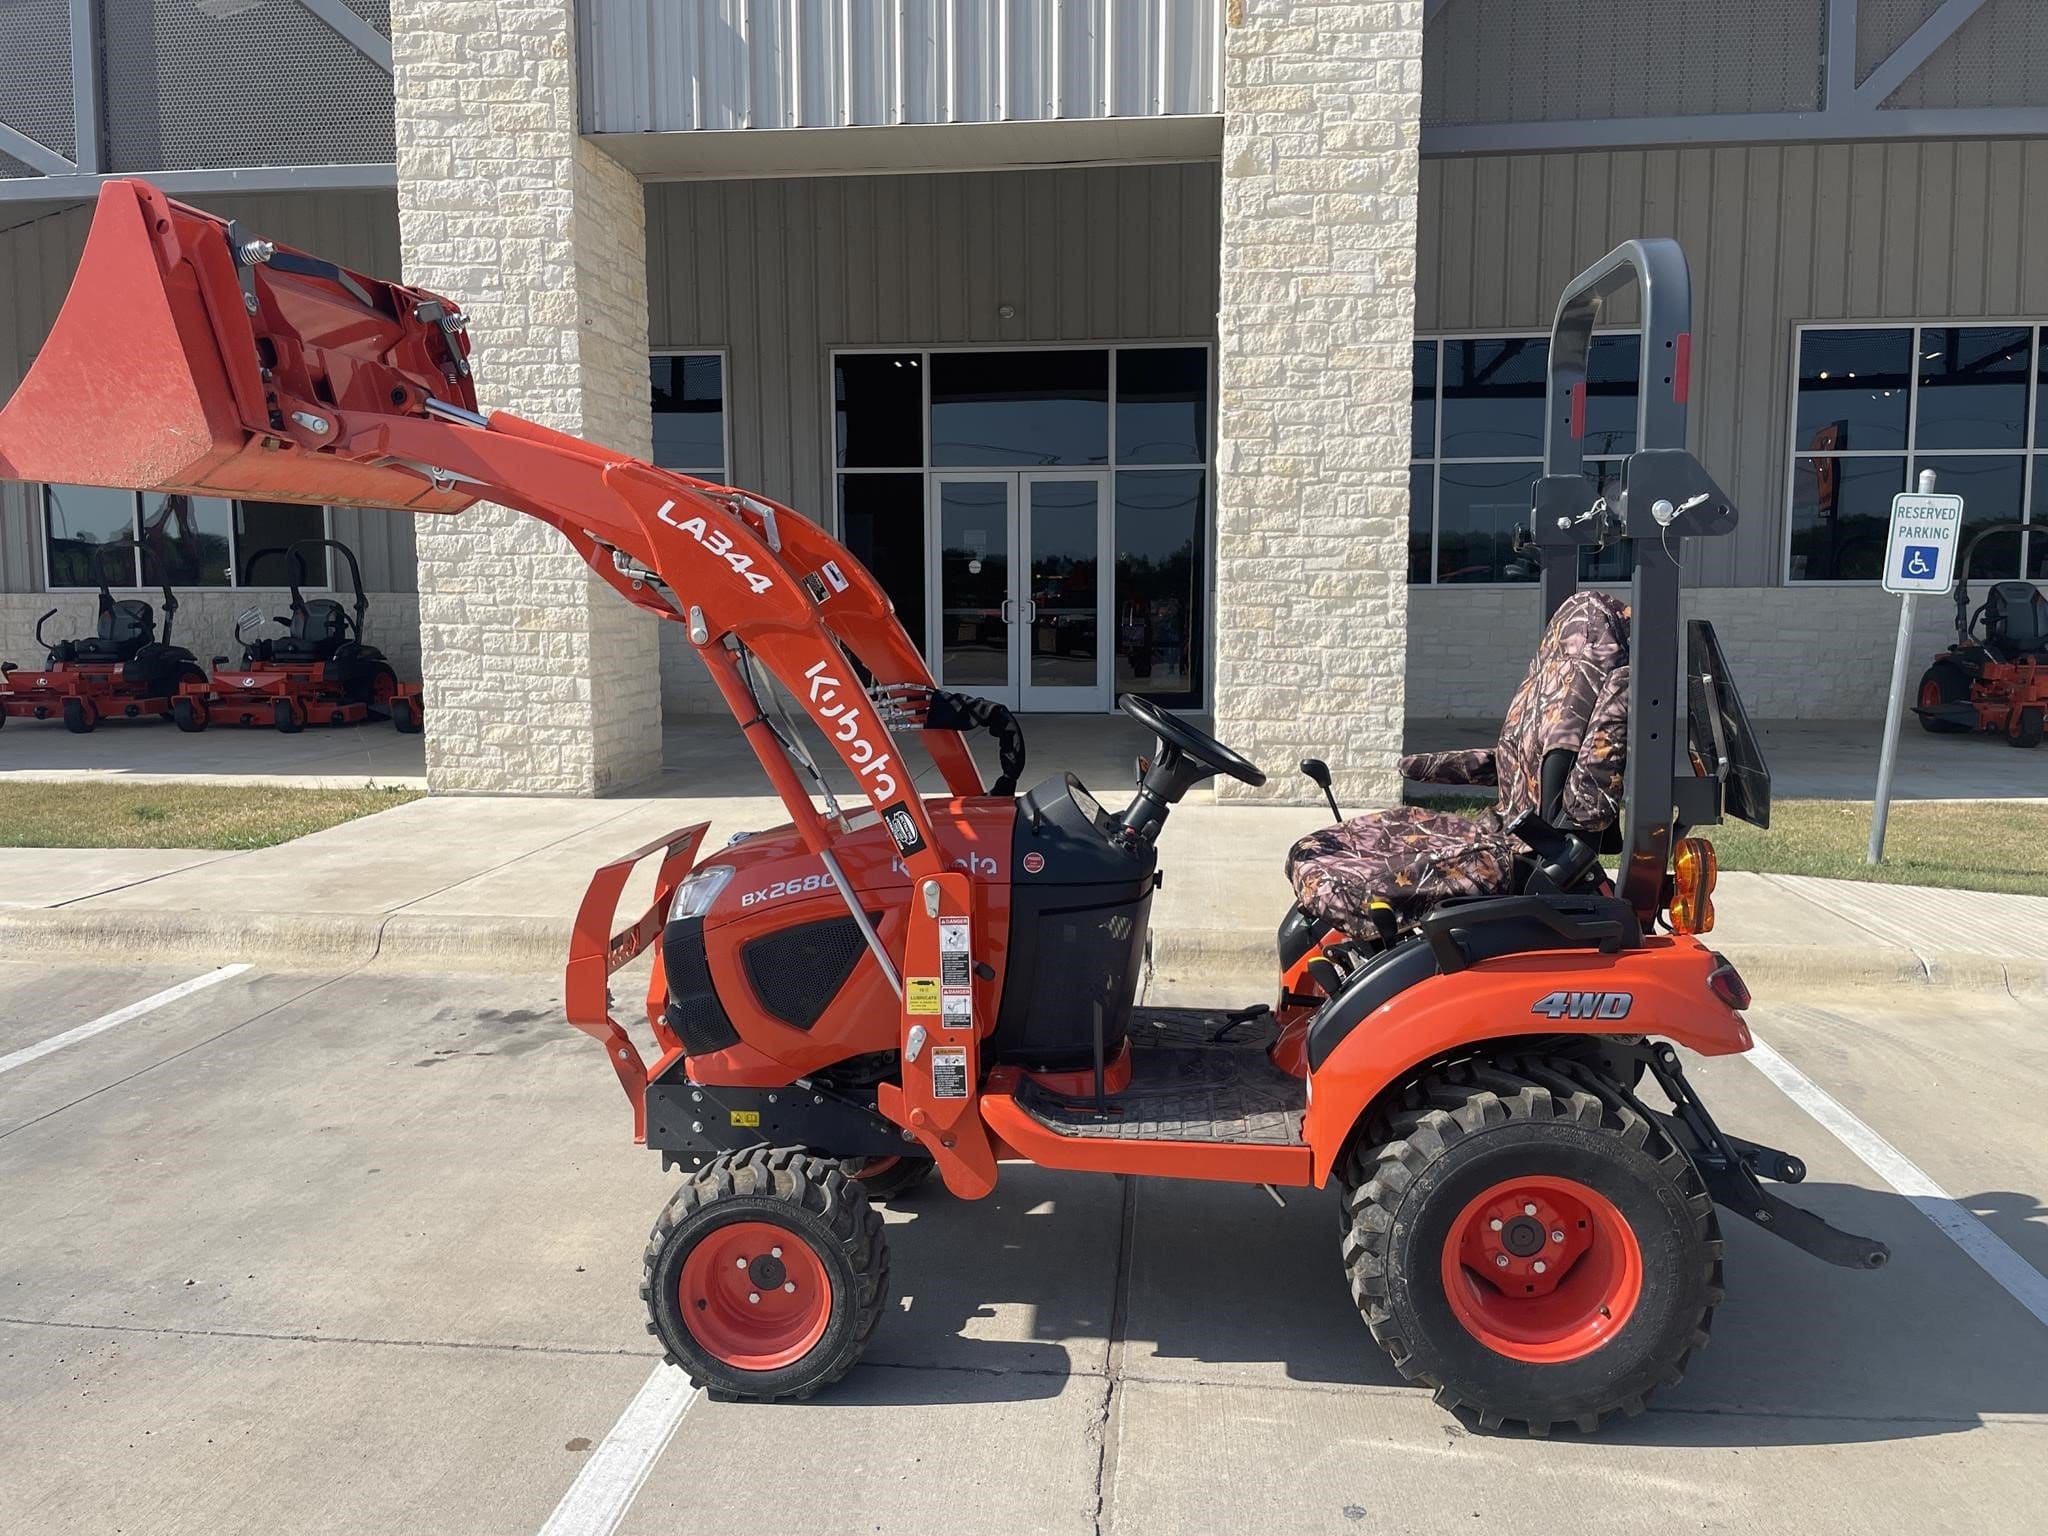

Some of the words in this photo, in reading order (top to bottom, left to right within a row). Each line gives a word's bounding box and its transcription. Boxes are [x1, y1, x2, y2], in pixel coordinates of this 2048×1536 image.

[1897, 506, 1956, 520] RESERVED
[657, 499, 774, 594] LA344
[1898, 526, 1950, 540] PARKING
[804, 660, 896, 802] Kubota
[1531, 991, 1633, 1019] 4WD
